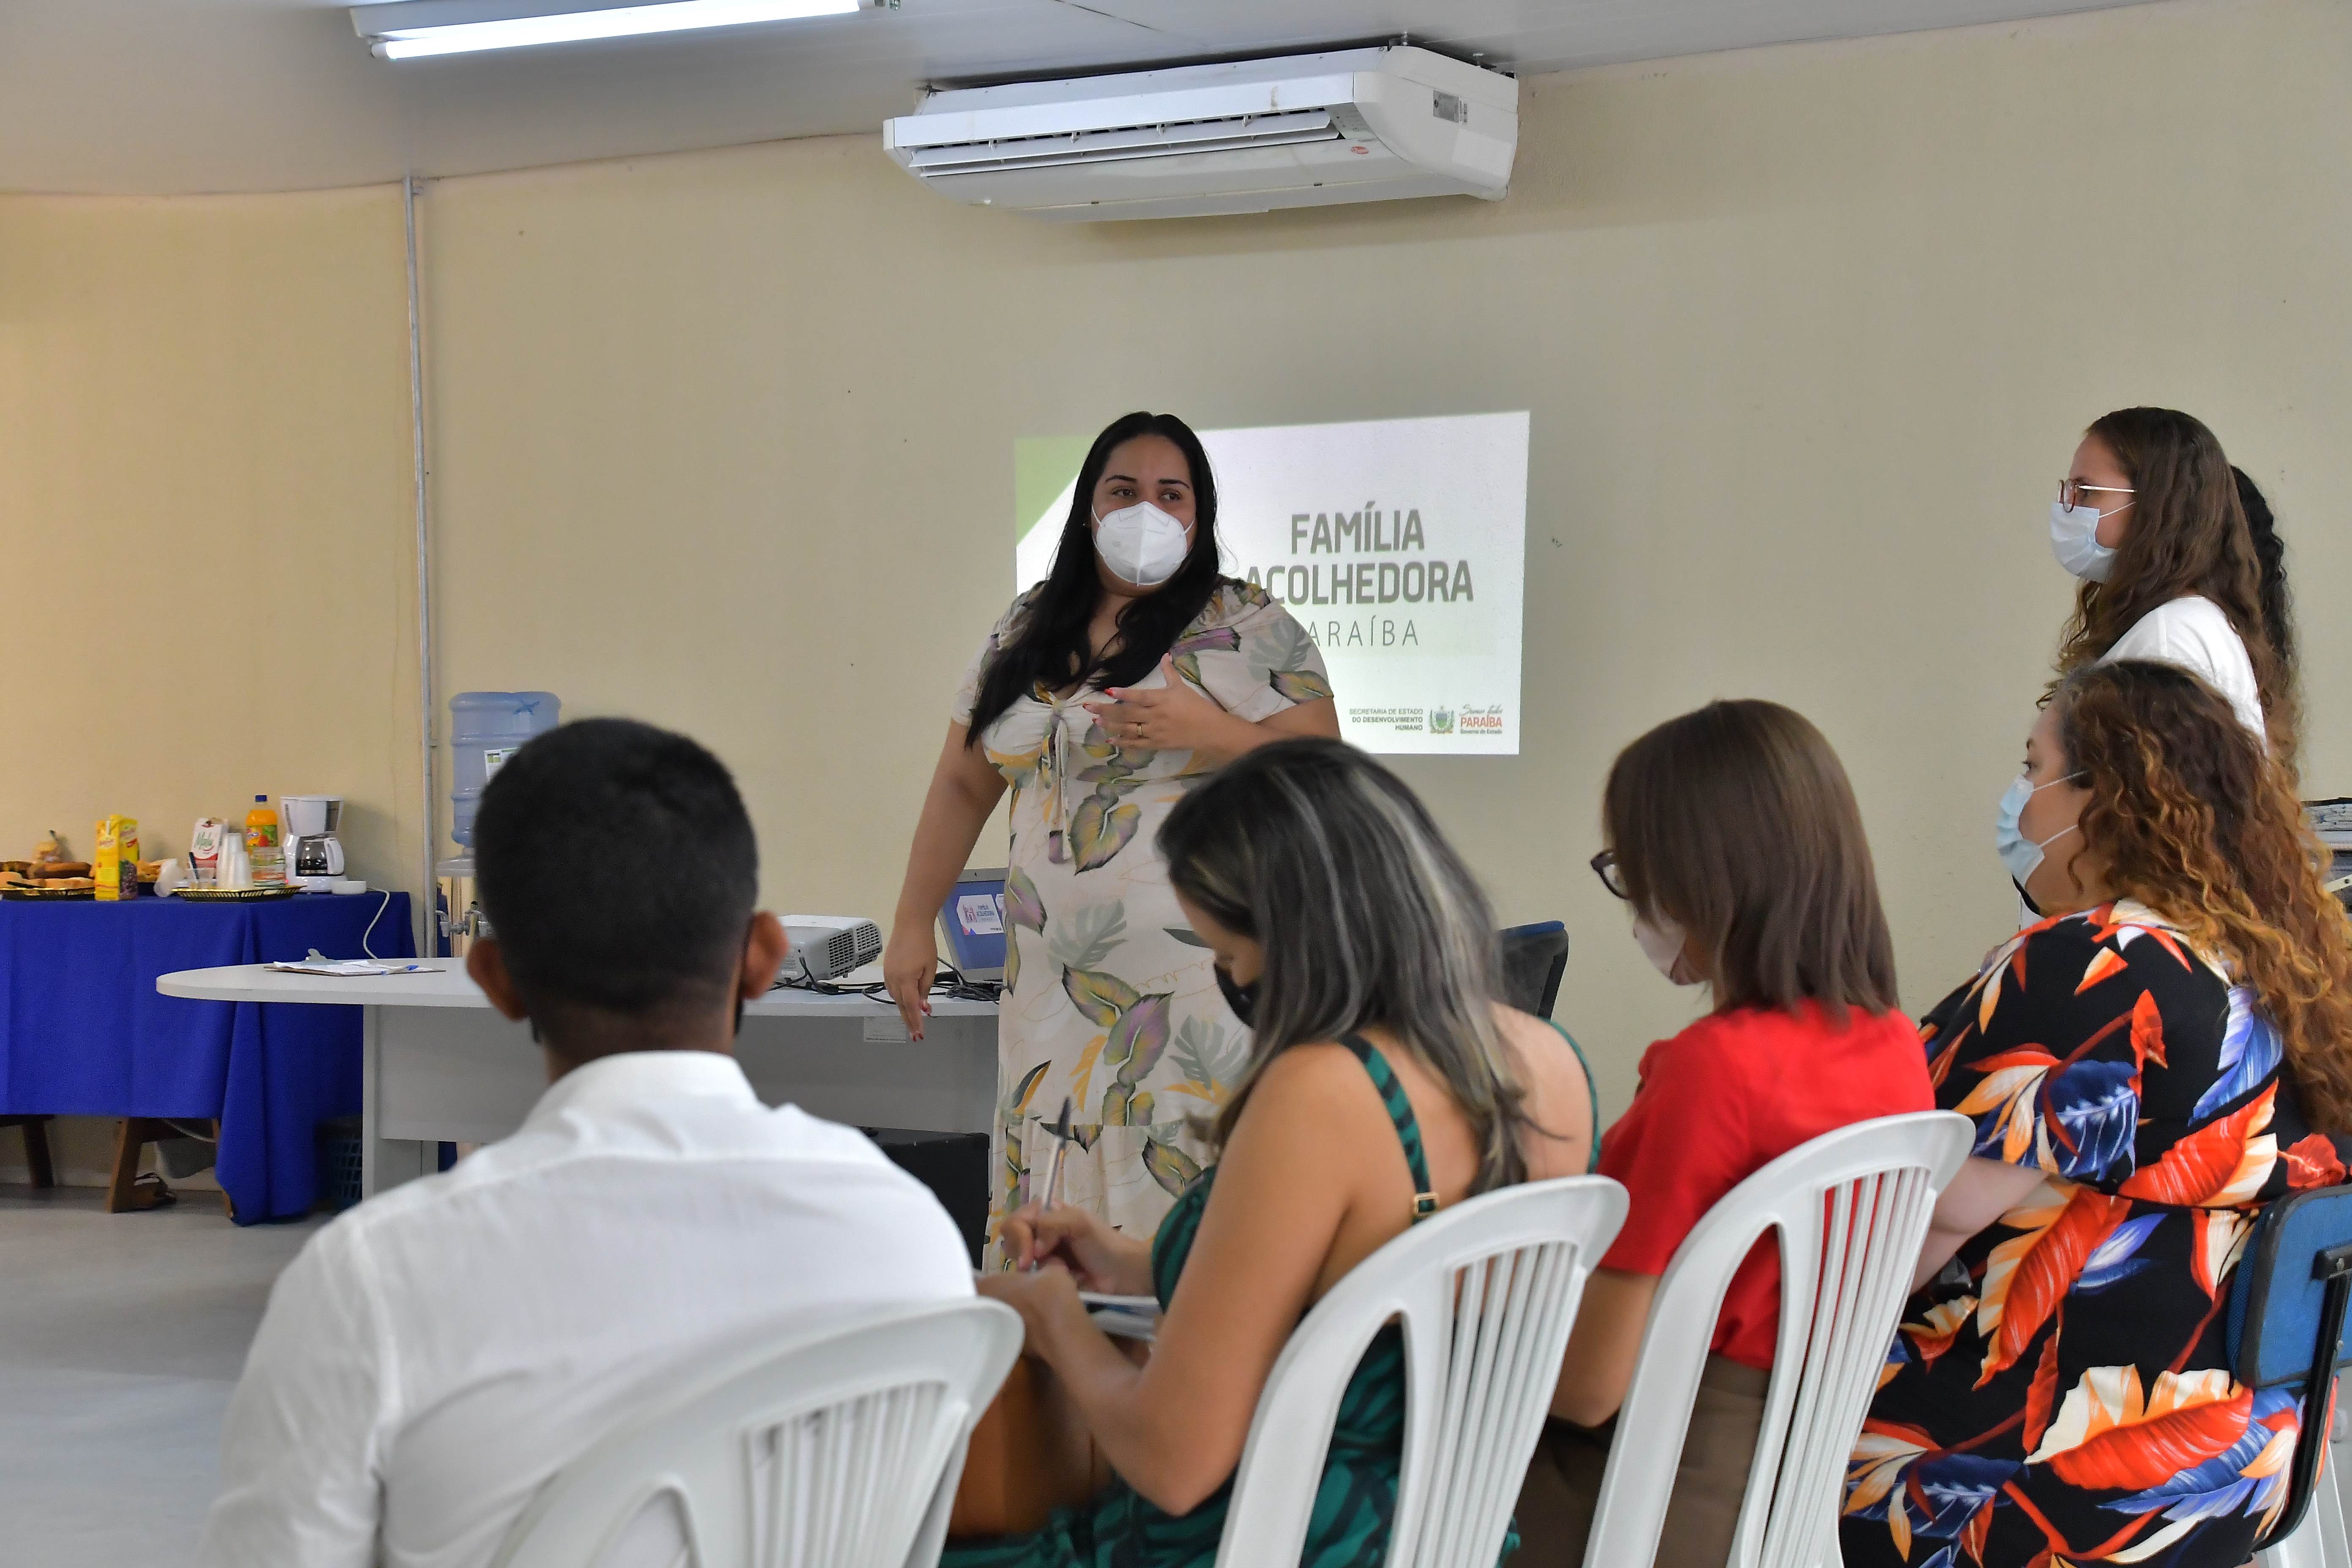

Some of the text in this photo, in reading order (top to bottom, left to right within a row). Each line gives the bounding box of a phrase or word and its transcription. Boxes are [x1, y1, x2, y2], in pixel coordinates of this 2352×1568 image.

[1291, 501, 1425, 554] FAMÍLIA
[1309, 615, 1418, 647] ARAÍBA
[1461, 715, 1502, 727] PARAÍBA
